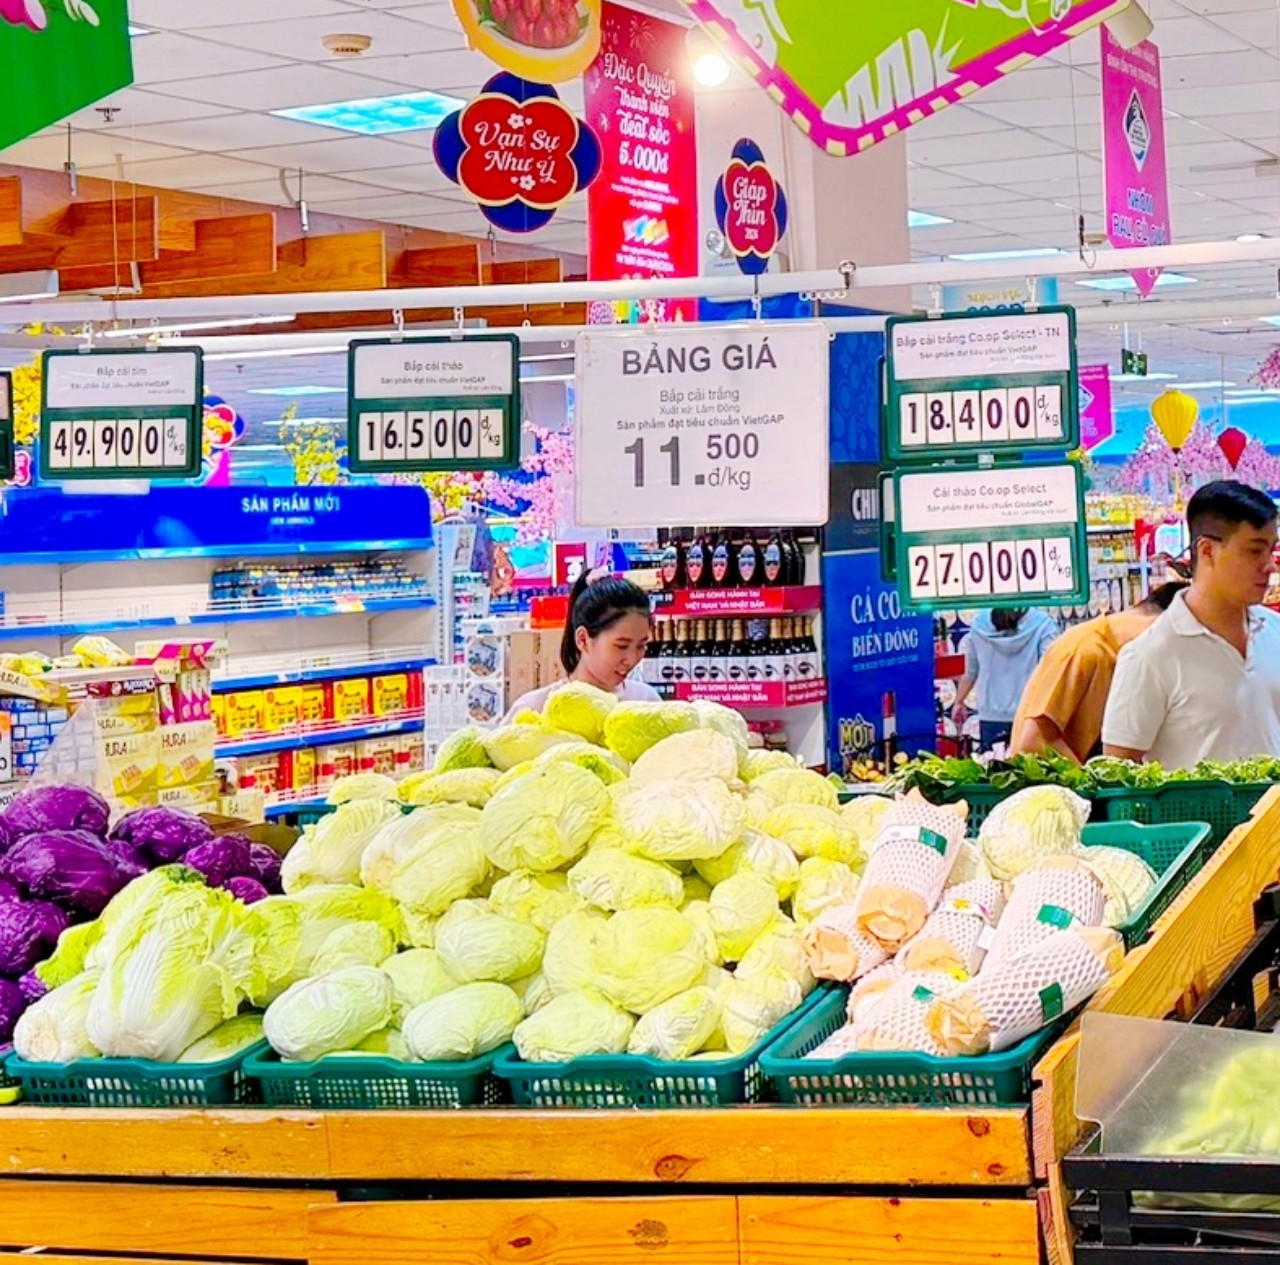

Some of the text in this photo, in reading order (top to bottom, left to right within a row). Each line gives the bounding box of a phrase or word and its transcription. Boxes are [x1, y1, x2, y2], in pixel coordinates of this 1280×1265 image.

[474, 121, 560, 153] Vạn Sự
[484, 150, 557, 184] Như Ý
[733, 176, 767, 207] Giáp
[622, 336, 777, 375] BẢNG GIÁ
[660, 386, 740, 404] Bắp cải trắng
[617, 413, 785, 431] Sản phẩm đạt tiêu chuẩn VietGAP
[908, 395, 1031, 434] 18.400
[55, 425, 159, 457] 49.900
[366, 417, 473, 451] 16.500
[708, 466, 751, 491] đ/kg
[242, 493, 269, 513] SẢN
[273, 492, 311, 513] PHẨM
[915, 548, 1037, 587] 27.000
[851, 586, 874, 624] CÁ
[162, 732, 187, 749] HURA
